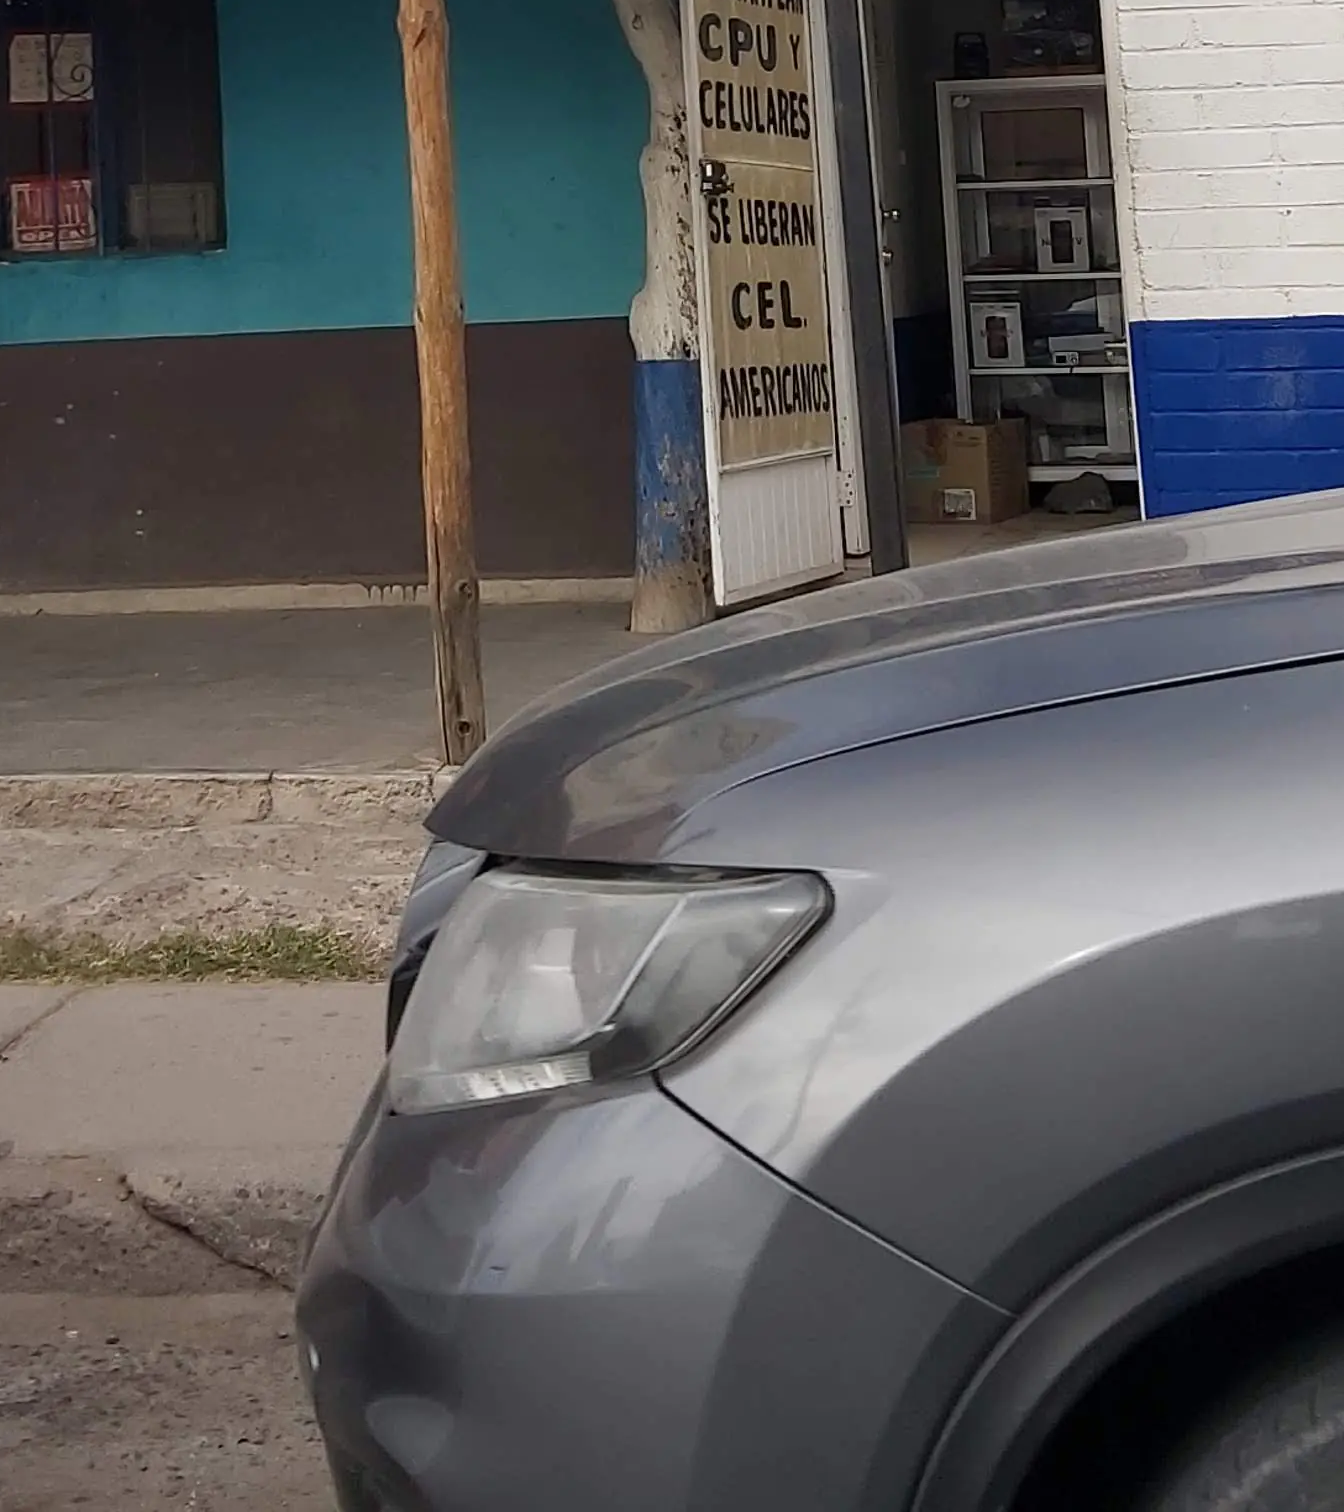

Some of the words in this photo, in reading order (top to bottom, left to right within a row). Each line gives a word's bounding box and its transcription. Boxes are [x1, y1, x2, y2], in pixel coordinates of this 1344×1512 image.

[697, 16, 778, 74] CPU
[788, 32, 802, 72] Y
[698, 78, 812, 142] CELULARES
[707, 193, 733, 246] SE
[739, 197, 816, 249] LIBERAN
[731, 280, 808, 330] CEL.
[718, 361, 831, 423] AMERICANOS
